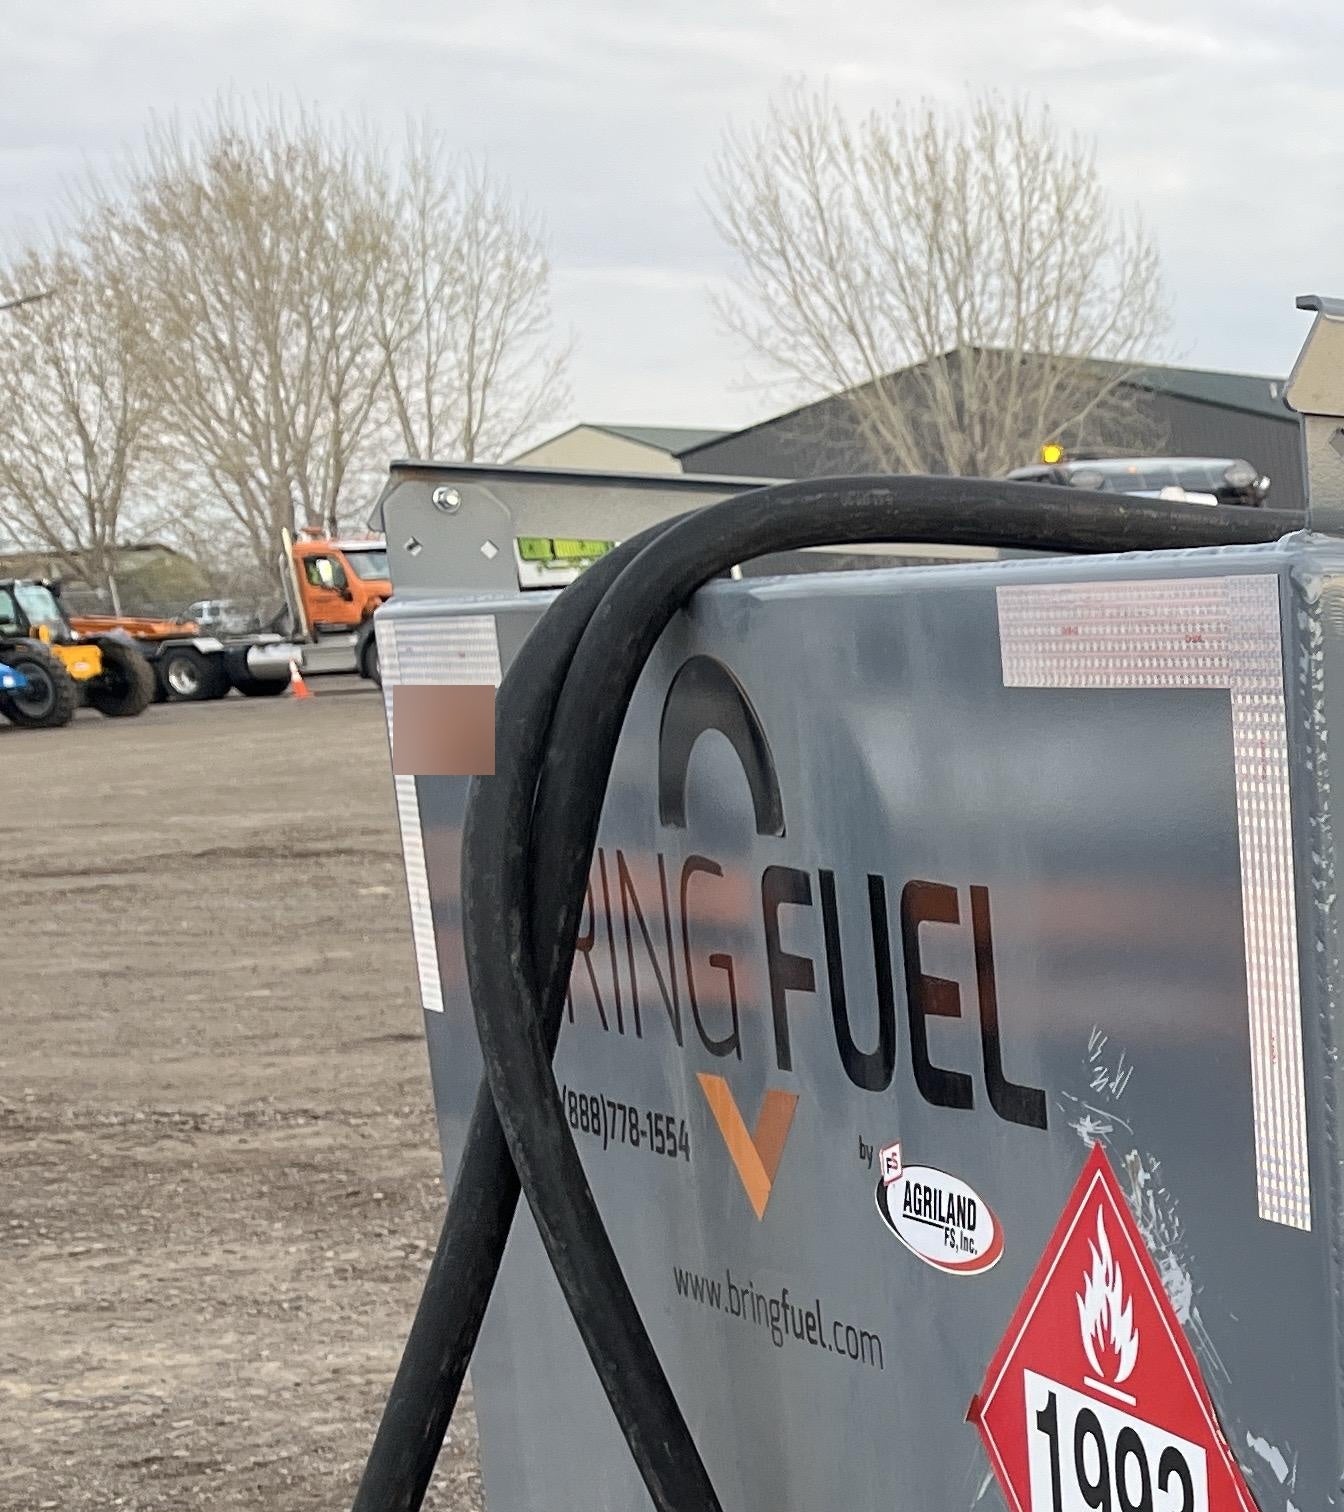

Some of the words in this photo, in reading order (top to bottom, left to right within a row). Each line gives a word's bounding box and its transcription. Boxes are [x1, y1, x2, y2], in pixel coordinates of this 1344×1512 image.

[761, 864, 1048, 1131] FUEL
[858, 1134, 874, 1170] by
[903, 1179, 977, 1232] AGRILAND
[943, 1226, 959, 1254] FS,
[959, 1229, 978, 1256] Inc.
[672, 1266, 884, 1370] www.bringfuel.com
